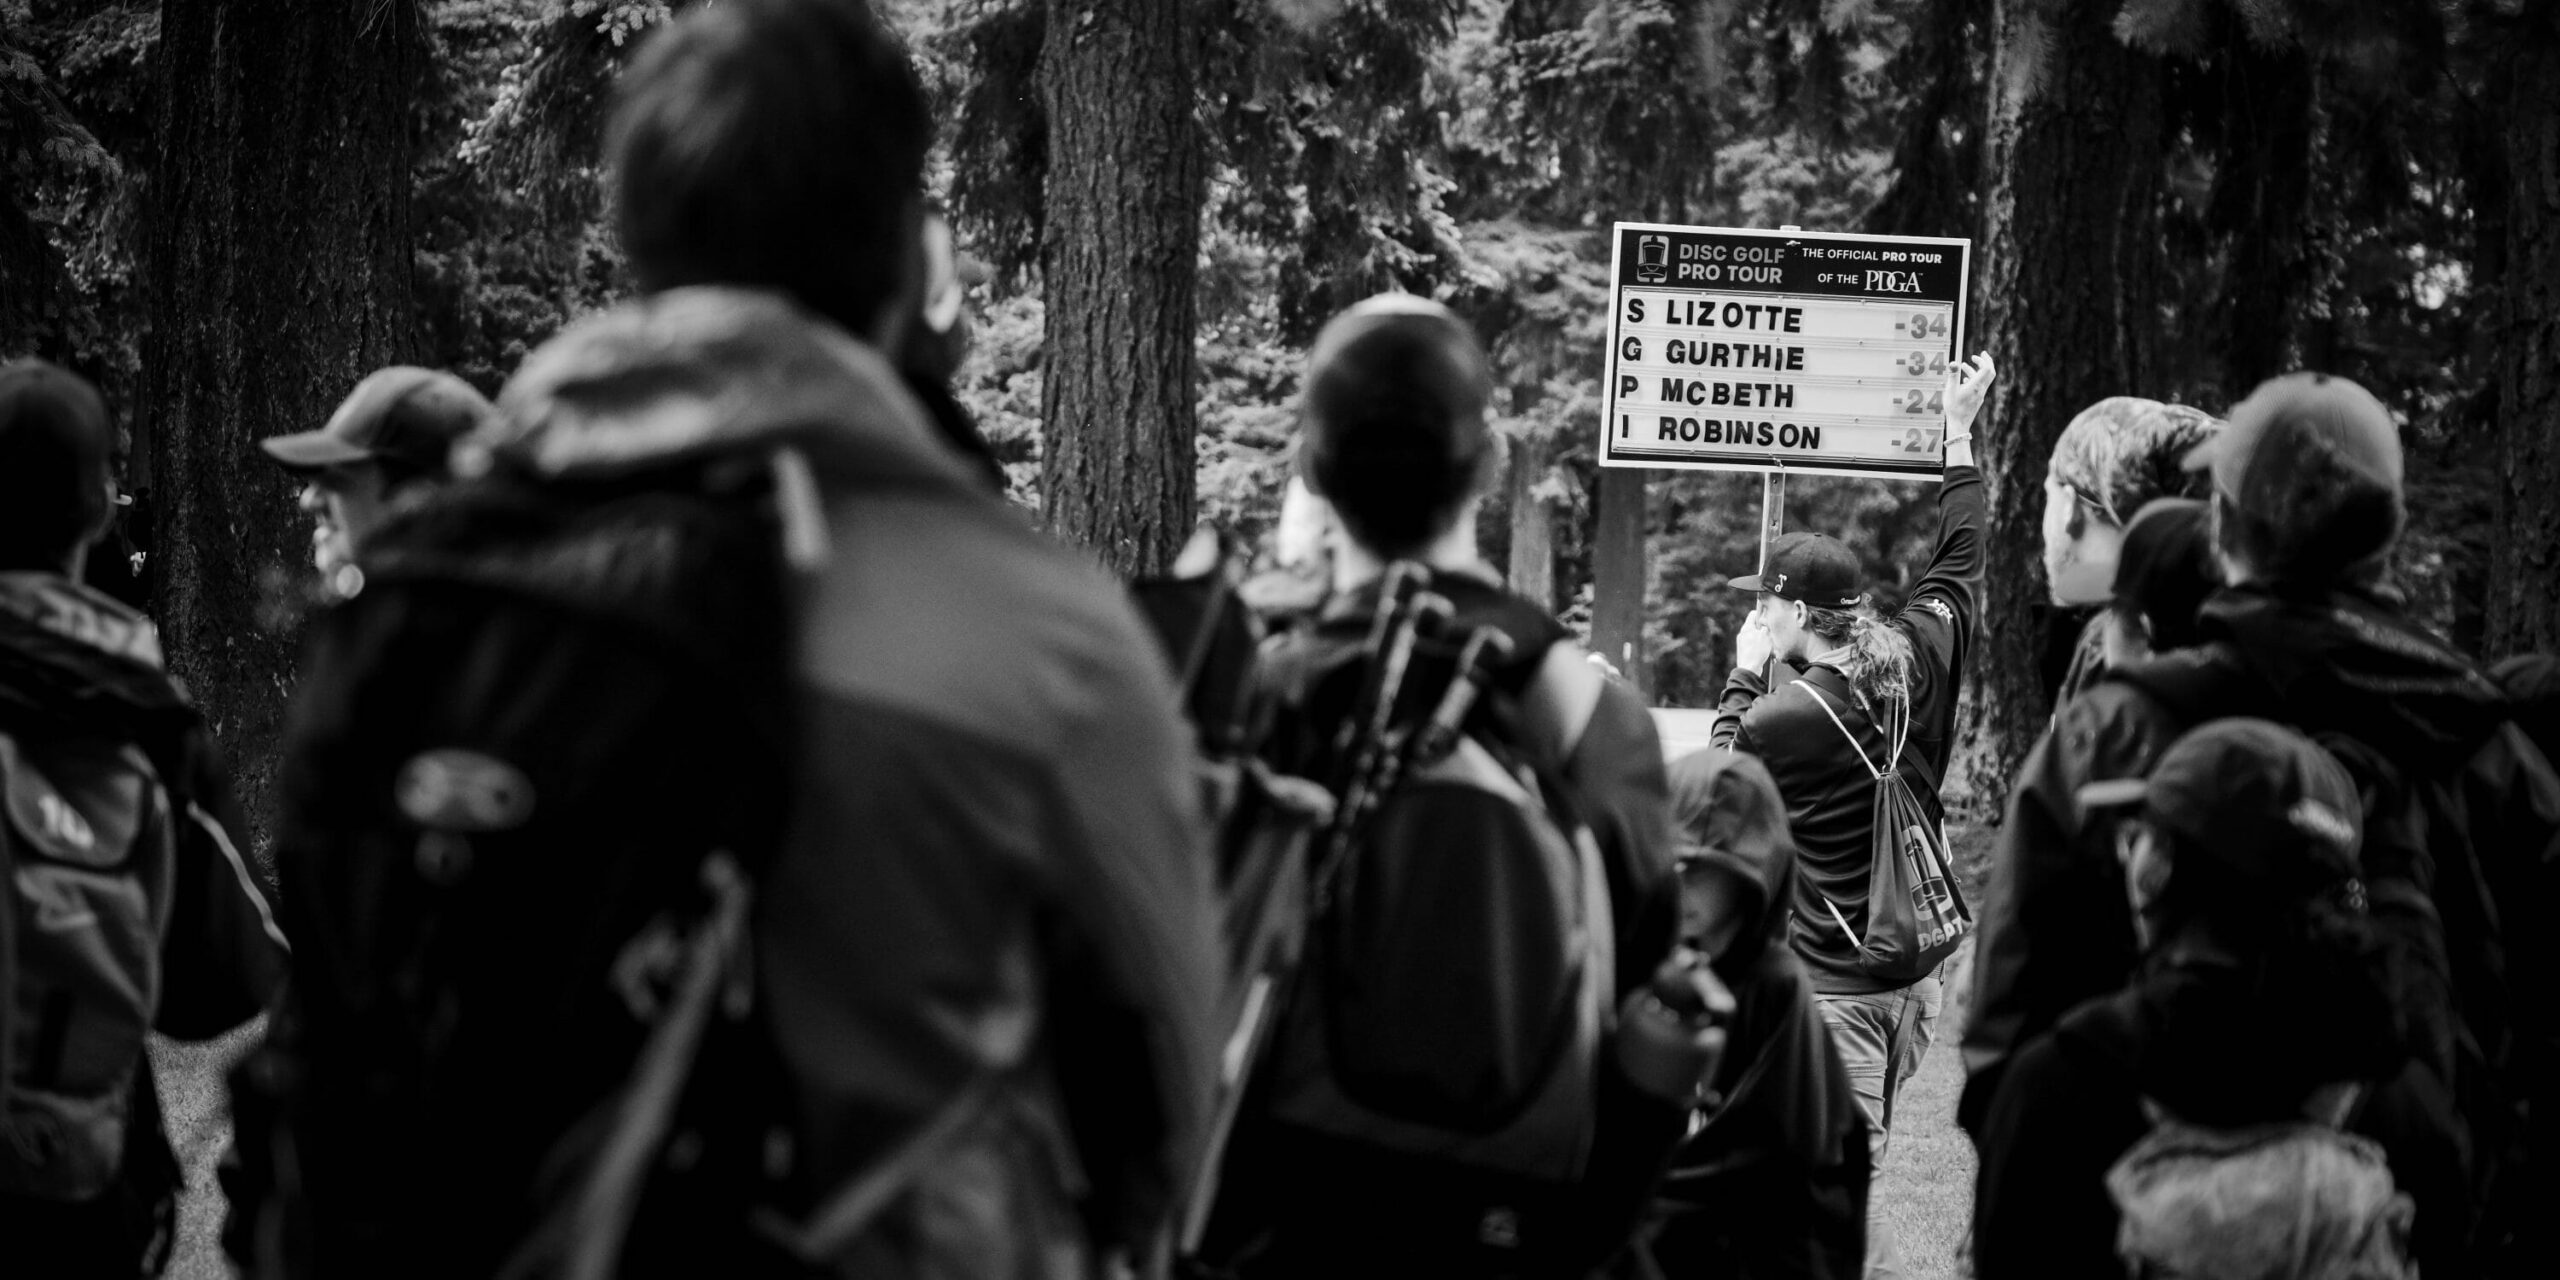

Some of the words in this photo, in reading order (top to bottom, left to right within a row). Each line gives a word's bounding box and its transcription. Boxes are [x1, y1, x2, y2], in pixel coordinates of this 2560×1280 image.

[1680, 244, 1727, 262] DISC
[1733, 246, 1785, 264] GOLF
[1803, 248, 1824, 258] THE
[1828, 249, 1879, 261] OFFICIAL
[1882, 252, 1907, 262] PRO
[1911, 253, 1942, 264] TOUR
[1678, 262, 1719, 281] PRO
[1728, 265, 1782, 284] TOUR
[1818, 273, 1833, 283] OF
[1837, 274, 1858, 284] THE
[1627, 298, 1644, 322] S
[1667, 300, 1803, 332] LIZOTTE
[1895, 314, 1947, 339] -34
[1622, 337, 1642, 361] G
[1666, 339, 1804, 371] GURTHIE
[1896, 351, 1946, 376] -34
[1620, 375, 1638, 398] P
[1893, 389, 1944, 414] -24
[1622, 415, 1628, 438] I
[1658, 417, 1820, 449] ROBINSON
[1891, 429, 1941, 453] -27
[1918, 917, 1963, 953] DGPT
